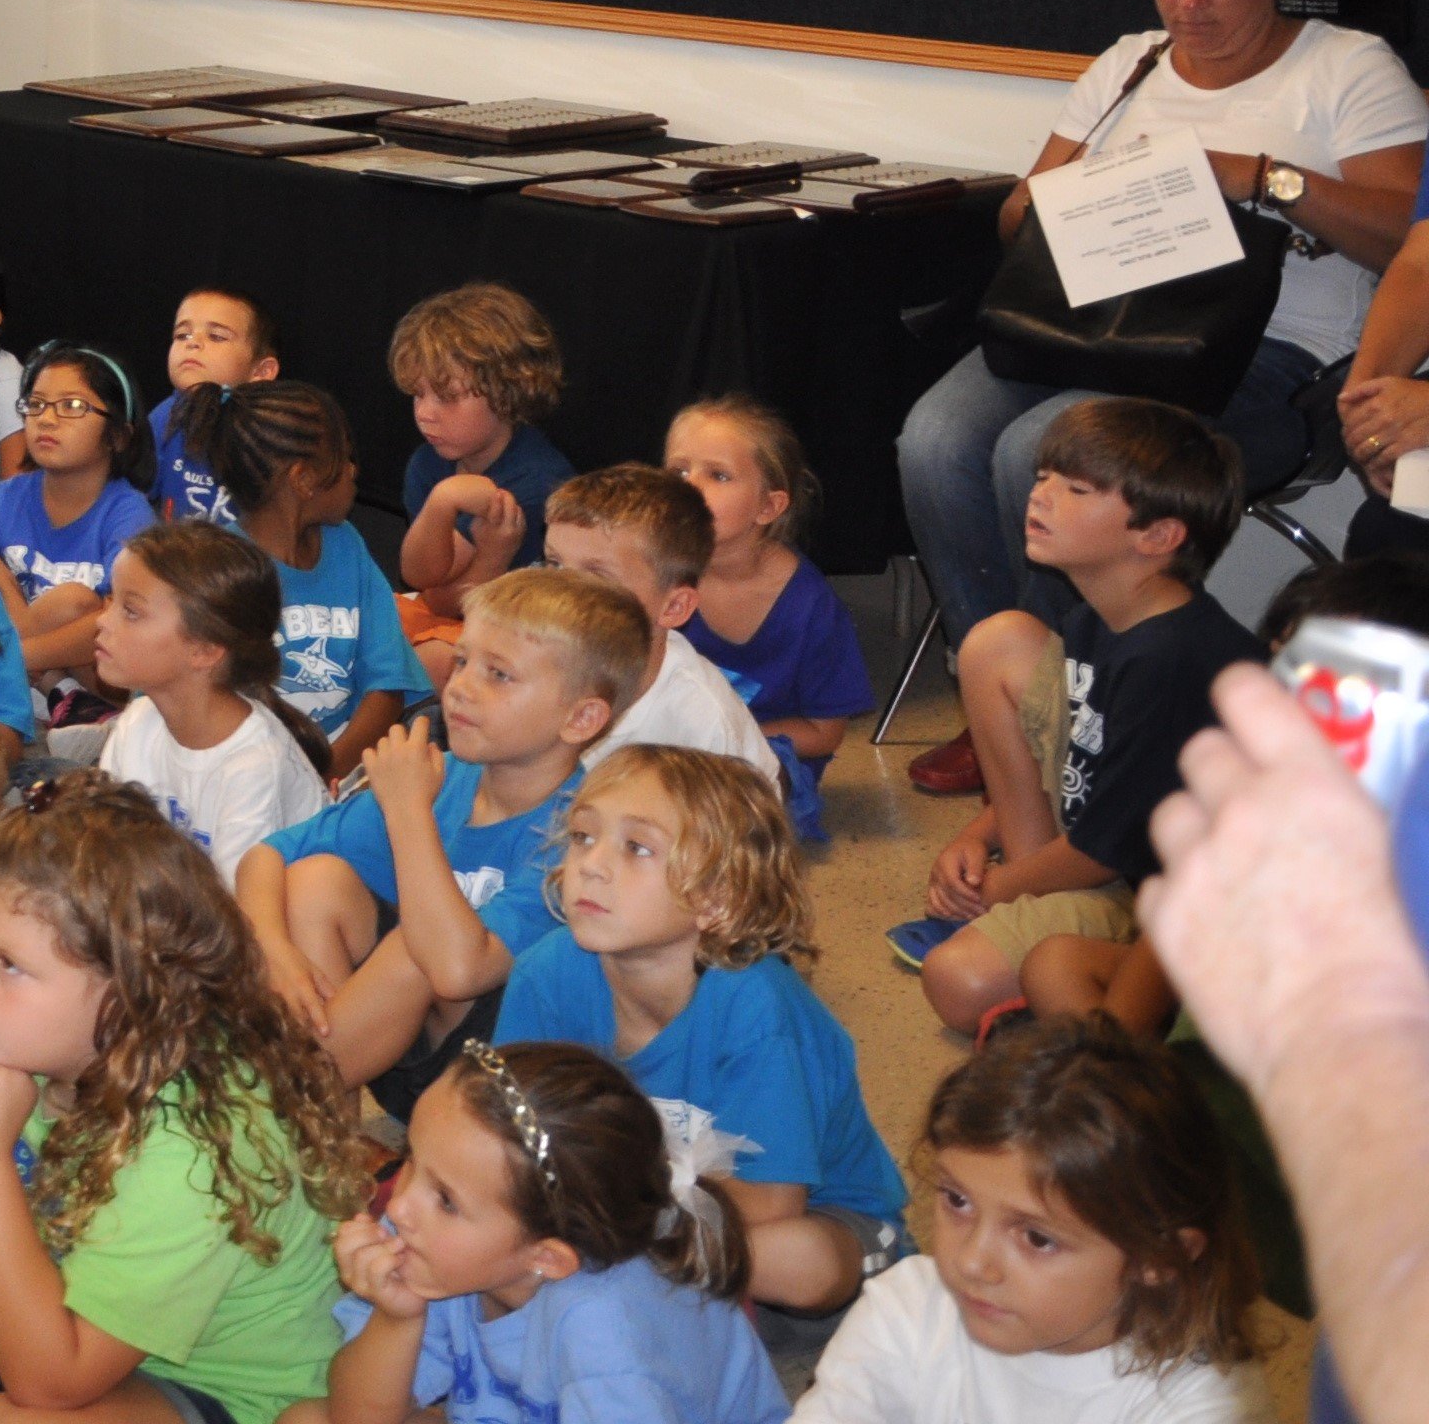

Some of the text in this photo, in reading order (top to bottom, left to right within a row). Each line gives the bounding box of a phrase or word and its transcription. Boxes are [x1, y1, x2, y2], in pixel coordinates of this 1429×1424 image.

[184, 472, 215, 487] AUL'S
[184, 485, 238, 522] 5K
[284, 604, 360, 640] BEA
